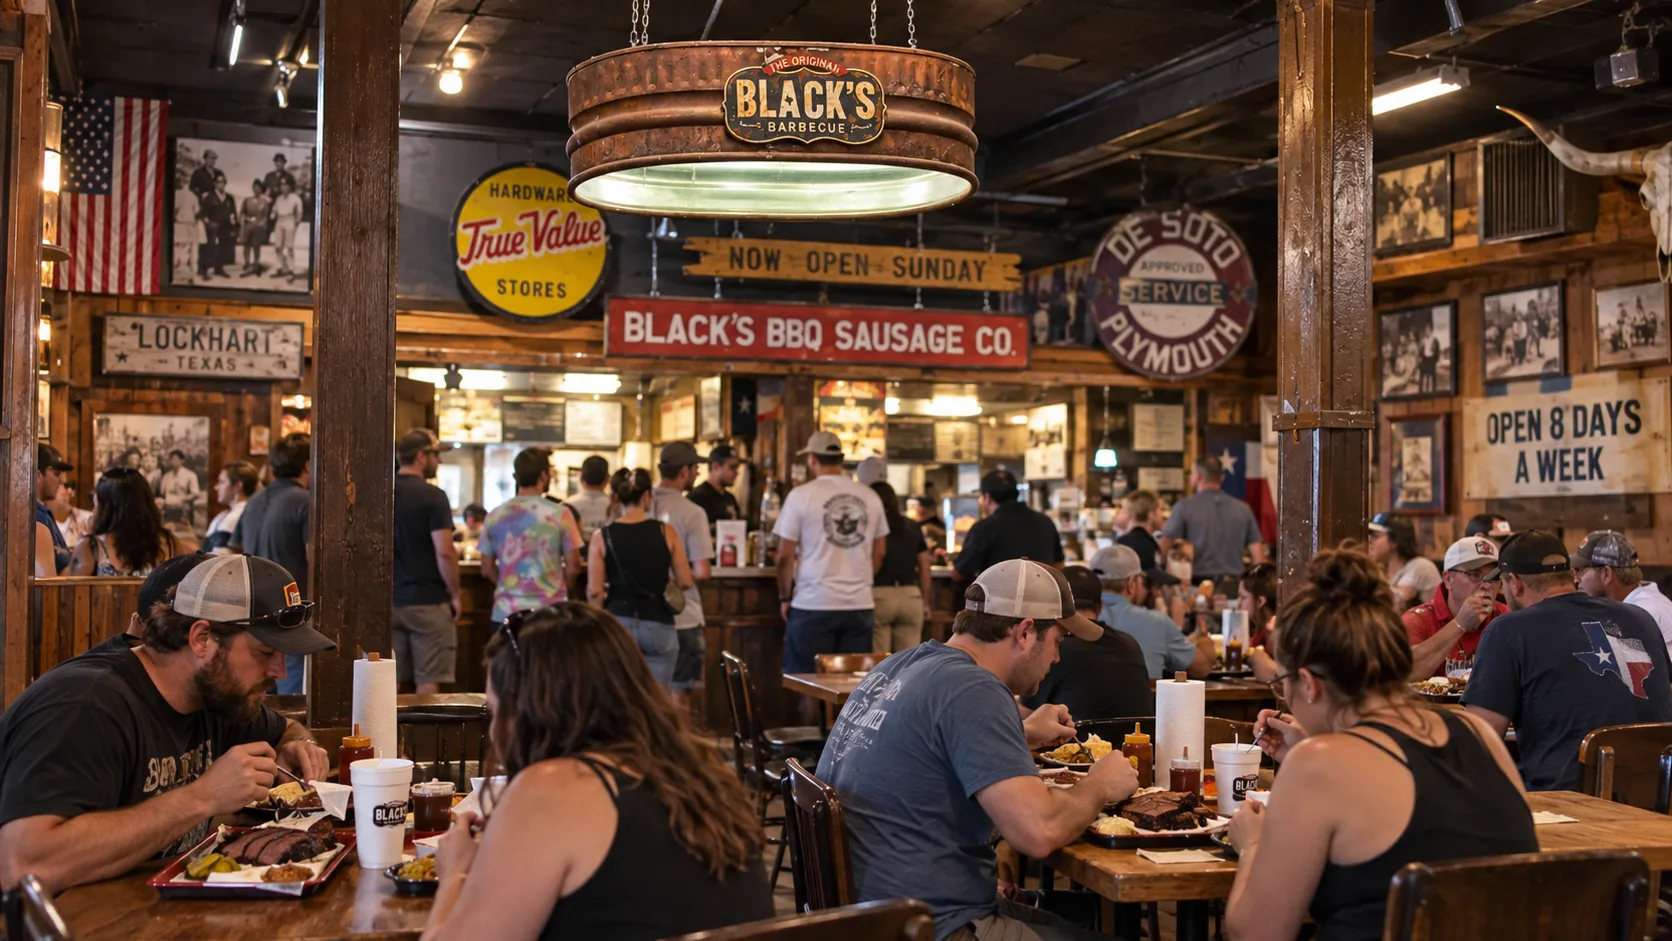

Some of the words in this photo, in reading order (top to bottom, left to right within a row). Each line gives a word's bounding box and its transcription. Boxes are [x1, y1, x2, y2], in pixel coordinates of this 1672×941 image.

[769, 58, 790, 73] THE
[735, 78, 876, 120] BLACK'S
[768, 121, 846, 134] BARBECUE
[459, 218, 526, 266] True
[517, 208, 602, 253] Value
[1105, 216, 1154, 266] DE
[1160, 210, 1242, 270] SOTO
[729, 246, 782, 272] NOW
[805, 250, 870, 277] OPEN
[892, 255, 988, 283] SUNDAY
[1140, 260, 1205, 275] APPROVED
[496, 278, 568, 299] STORES
[1120, 280, 1224, 305] SERVICE
[137, 323, 275, 354] LOCKHART
[623, 310, 756, 347] BLACK'S
[766, 317, 823, 352] BBQ
[834, 320, 965, 355] SAUSAGE
[975, 326, 1018, 357] CO.
[1100, 311, 1244, 374] PLYMOUTH
[176, 355, 237, 372] TEXAS
[1486, 408, 1542, 445] OPEN
[1550, 406, 1565, 441] 8
[1573, 399, 1643, 439] DAYS
[1514, 451, 1530, 484] A
[1537, 446, 1604, 482] WEEK
